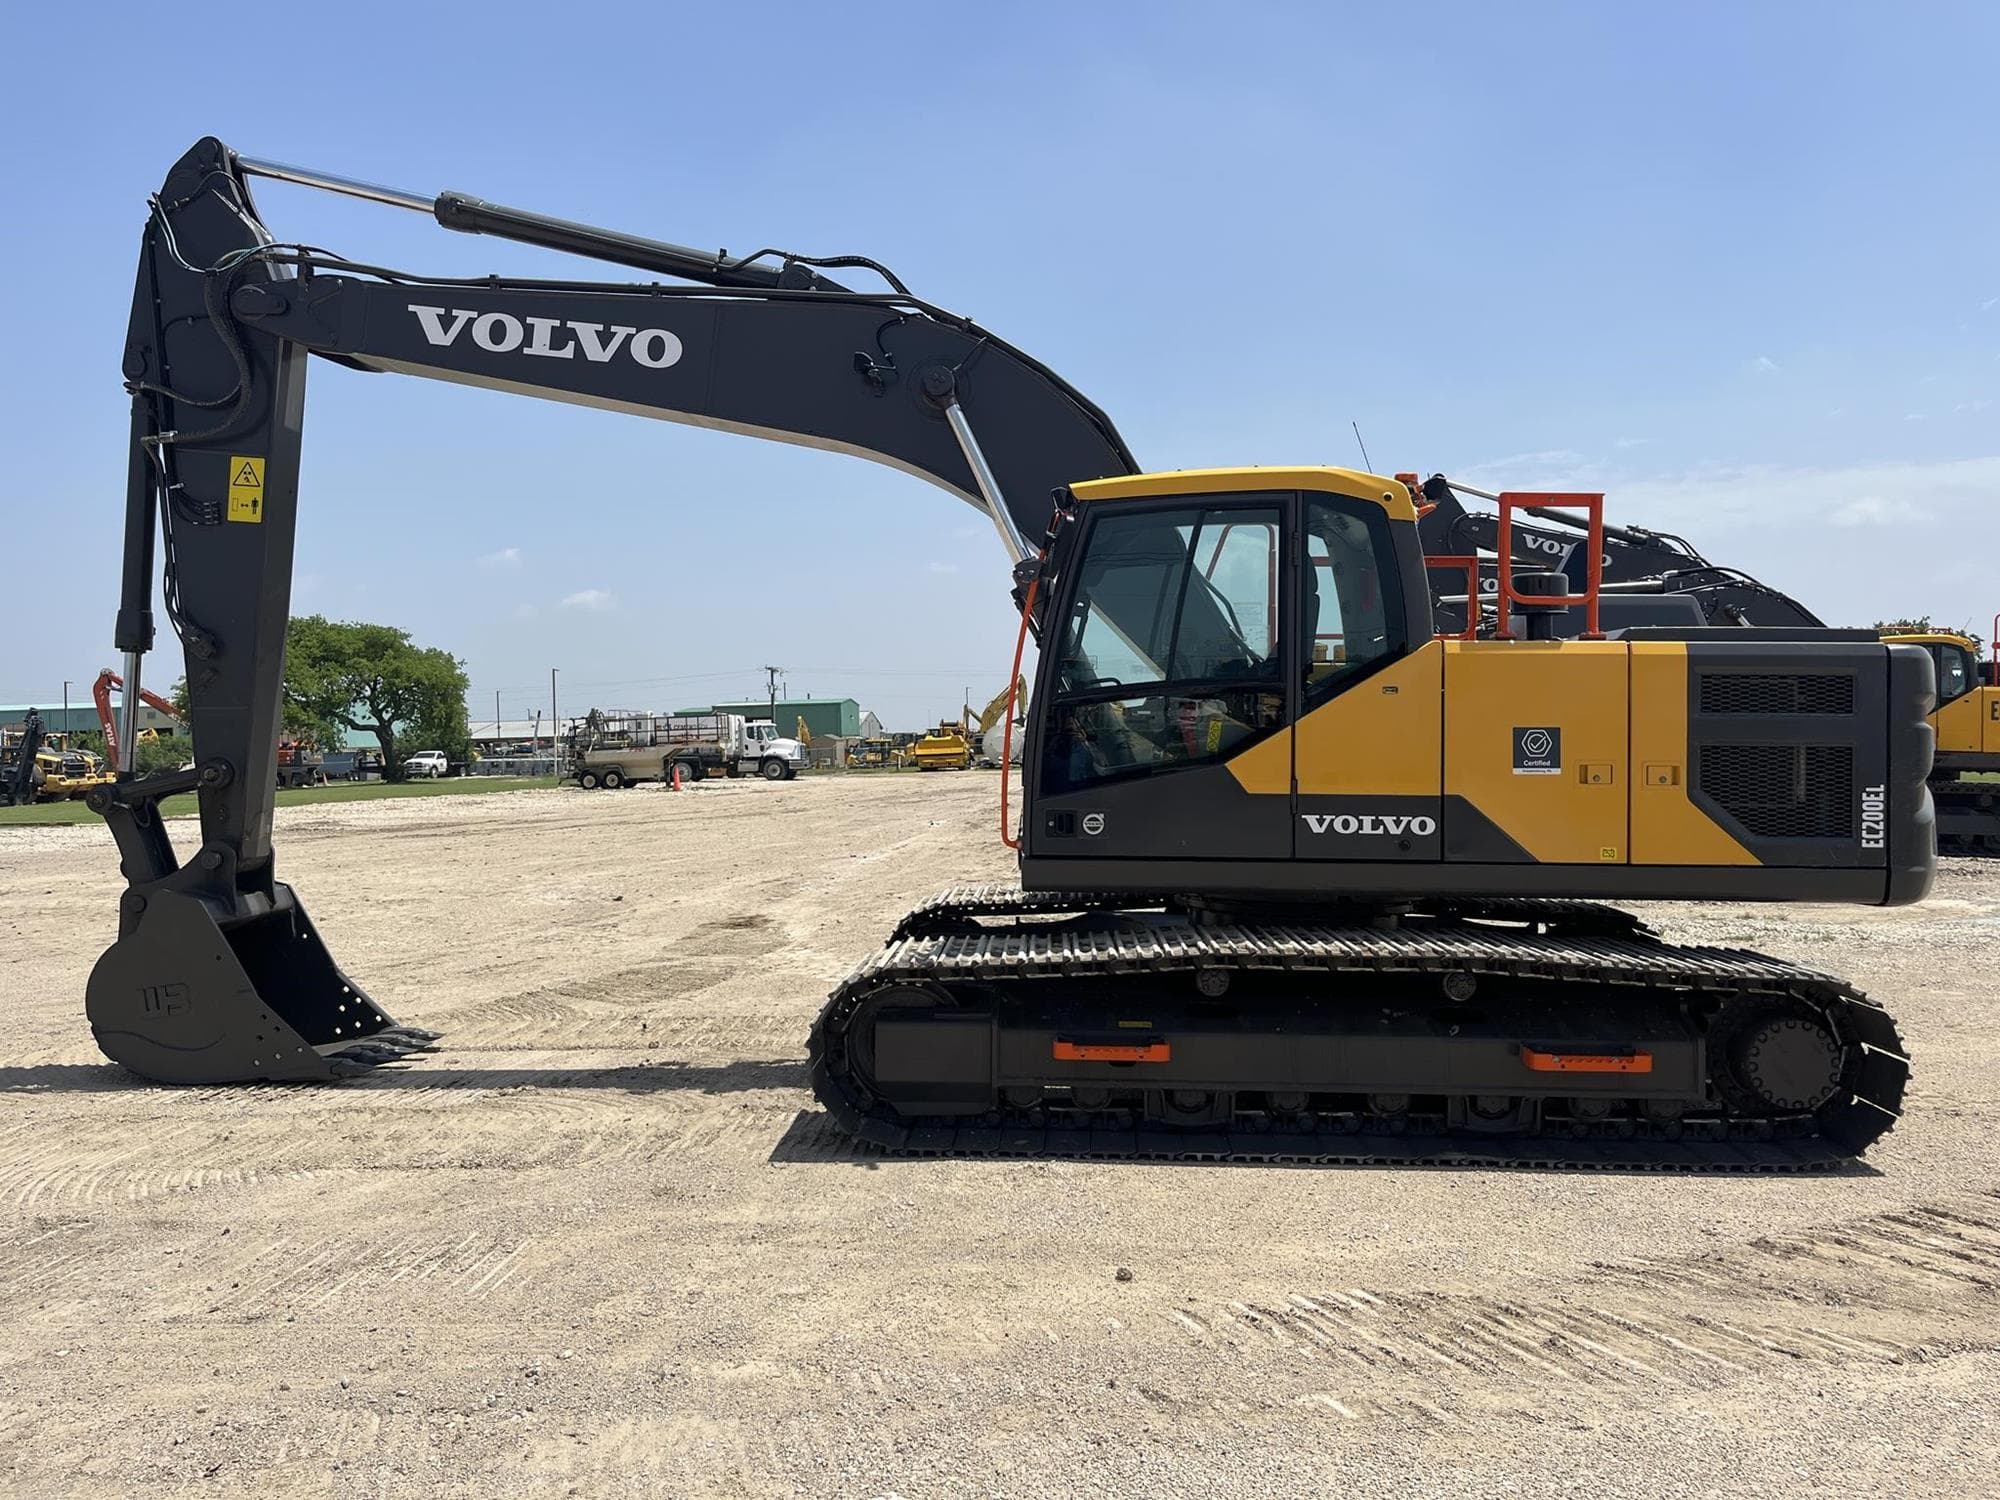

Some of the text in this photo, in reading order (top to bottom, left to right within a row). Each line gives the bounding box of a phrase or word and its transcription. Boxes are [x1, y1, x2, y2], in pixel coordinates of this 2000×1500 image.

[407, 304, 683, 369] VOLVO
[104, 722, 116, 747] ATLAS
[1301, 815, 1436, 835] VOLVO
[1861, 784, 1885, 848] EC200EL
